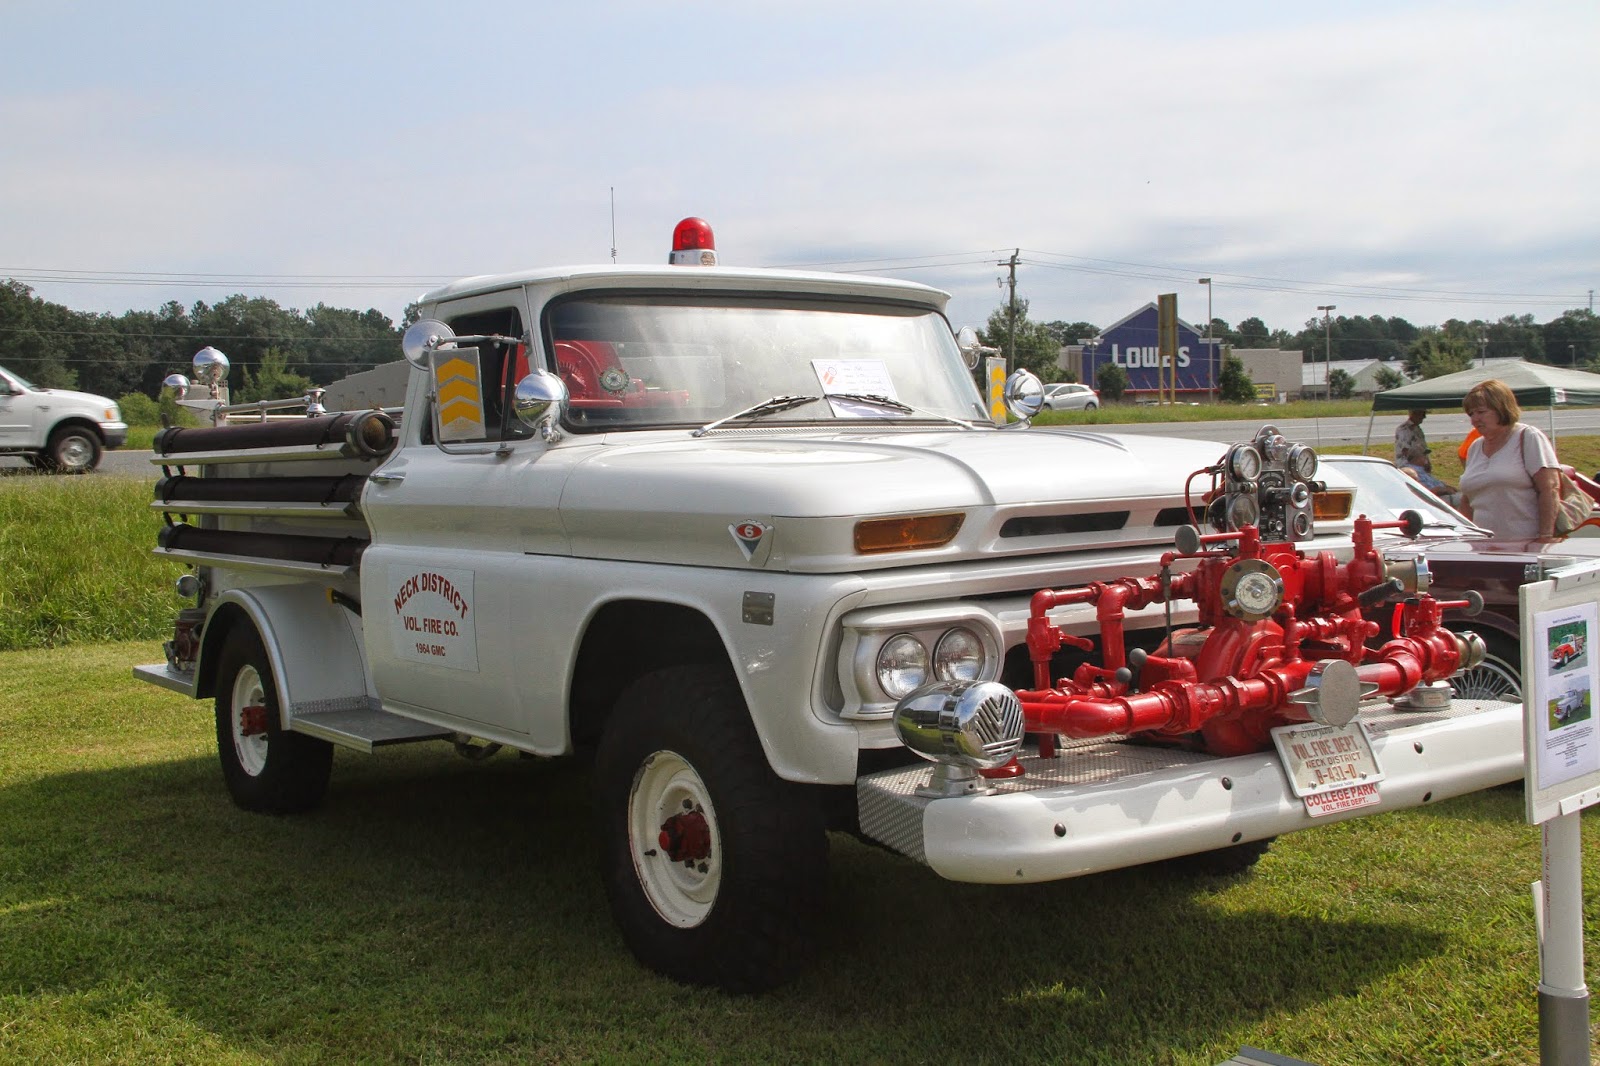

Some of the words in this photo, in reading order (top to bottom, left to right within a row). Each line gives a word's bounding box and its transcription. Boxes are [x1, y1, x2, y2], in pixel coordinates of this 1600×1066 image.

[744, 525, 754, 537] 6
[394, 575, 419, 614] NECK
[421, 573, 468, 619] DISTRICT
[403, 616, 421, 631] VOL.
[423, 618, 442, 634] FIRE
[444, 620, 459, 636] CO.
[416, 643, 430, 654] 1964
[431, 645, 446, 656] GMC
[1306, 759, 1327, 769] NECK
[1327, 752, 1361, 765] DISTRICT
[1306, 787, 1351, 807] COLLEGE
[1351, 783, 1377, 798] PARK
[1321, 803, 1336, 812] VOL.
[1336, 800, 1351, 809] FIRE
[1351, 797, 1369, 806] DEPT.
